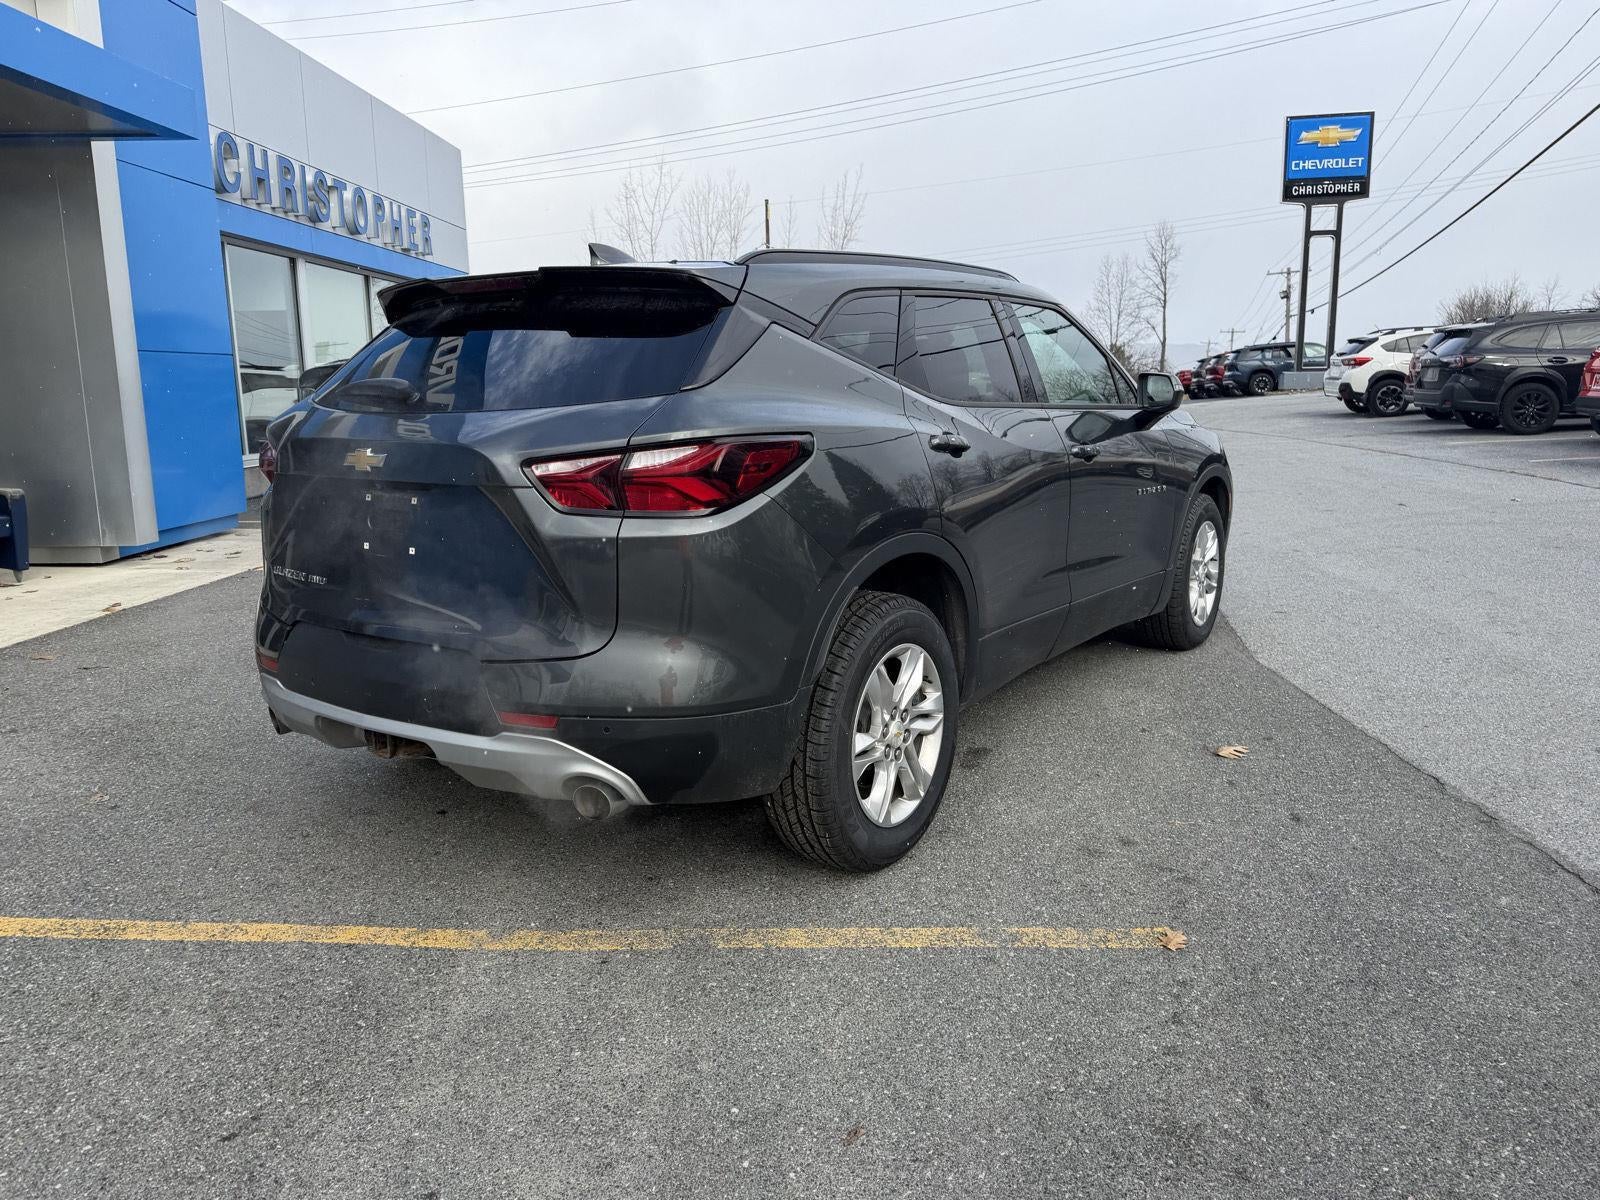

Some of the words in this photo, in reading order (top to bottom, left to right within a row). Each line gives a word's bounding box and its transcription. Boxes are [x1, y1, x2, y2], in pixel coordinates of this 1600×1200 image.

[1291, 157, 1365, 171] CHEVROLET
[214, 131, 434, 257] CHRISTOPHER
[1291, 182, 1361, 196] CHRISTOPHER
